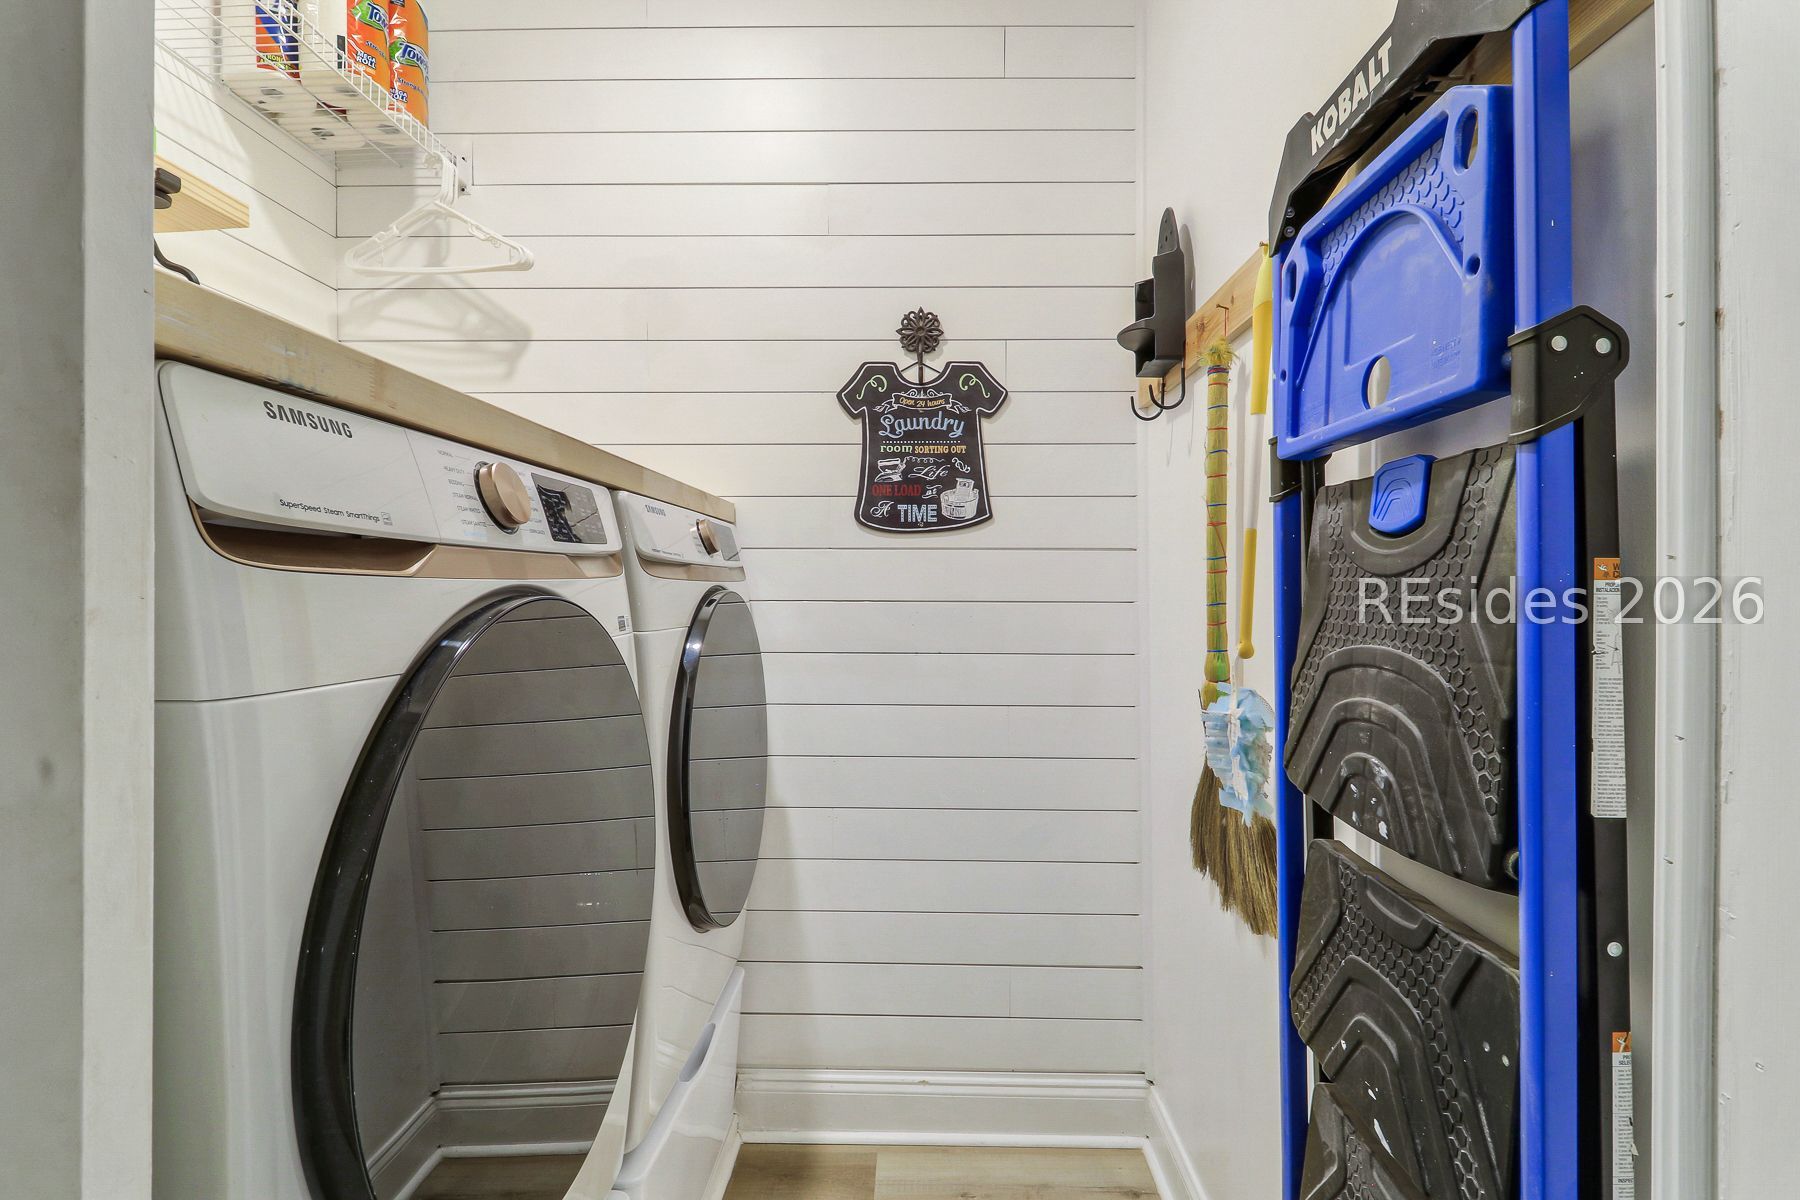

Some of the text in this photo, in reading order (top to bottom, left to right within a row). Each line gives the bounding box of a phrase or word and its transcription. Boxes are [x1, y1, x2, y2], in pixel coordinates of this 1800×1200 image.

[356, 56, 376, 69] ROLL
[1310, 36, 1392, 157] KOBALT
[899, 397, 945, 408] Open 24 hours
[263, 400, 353, 440] SAMSUNG
[878, 411, 965, 438] Laundry
[879, 444, 967, 454] room SORTING OUT
[908, 464, 950, 480] Life
[871, 483, 892, 496] ONE
[893, 482, 922, 496] LOAD
[279, 498, 321, 513] SuperSpeed
[323, 506, 345, 517] Steam
[345, 510, 381, 524] SmartThings
[897, 504, 939, 523] TIME
